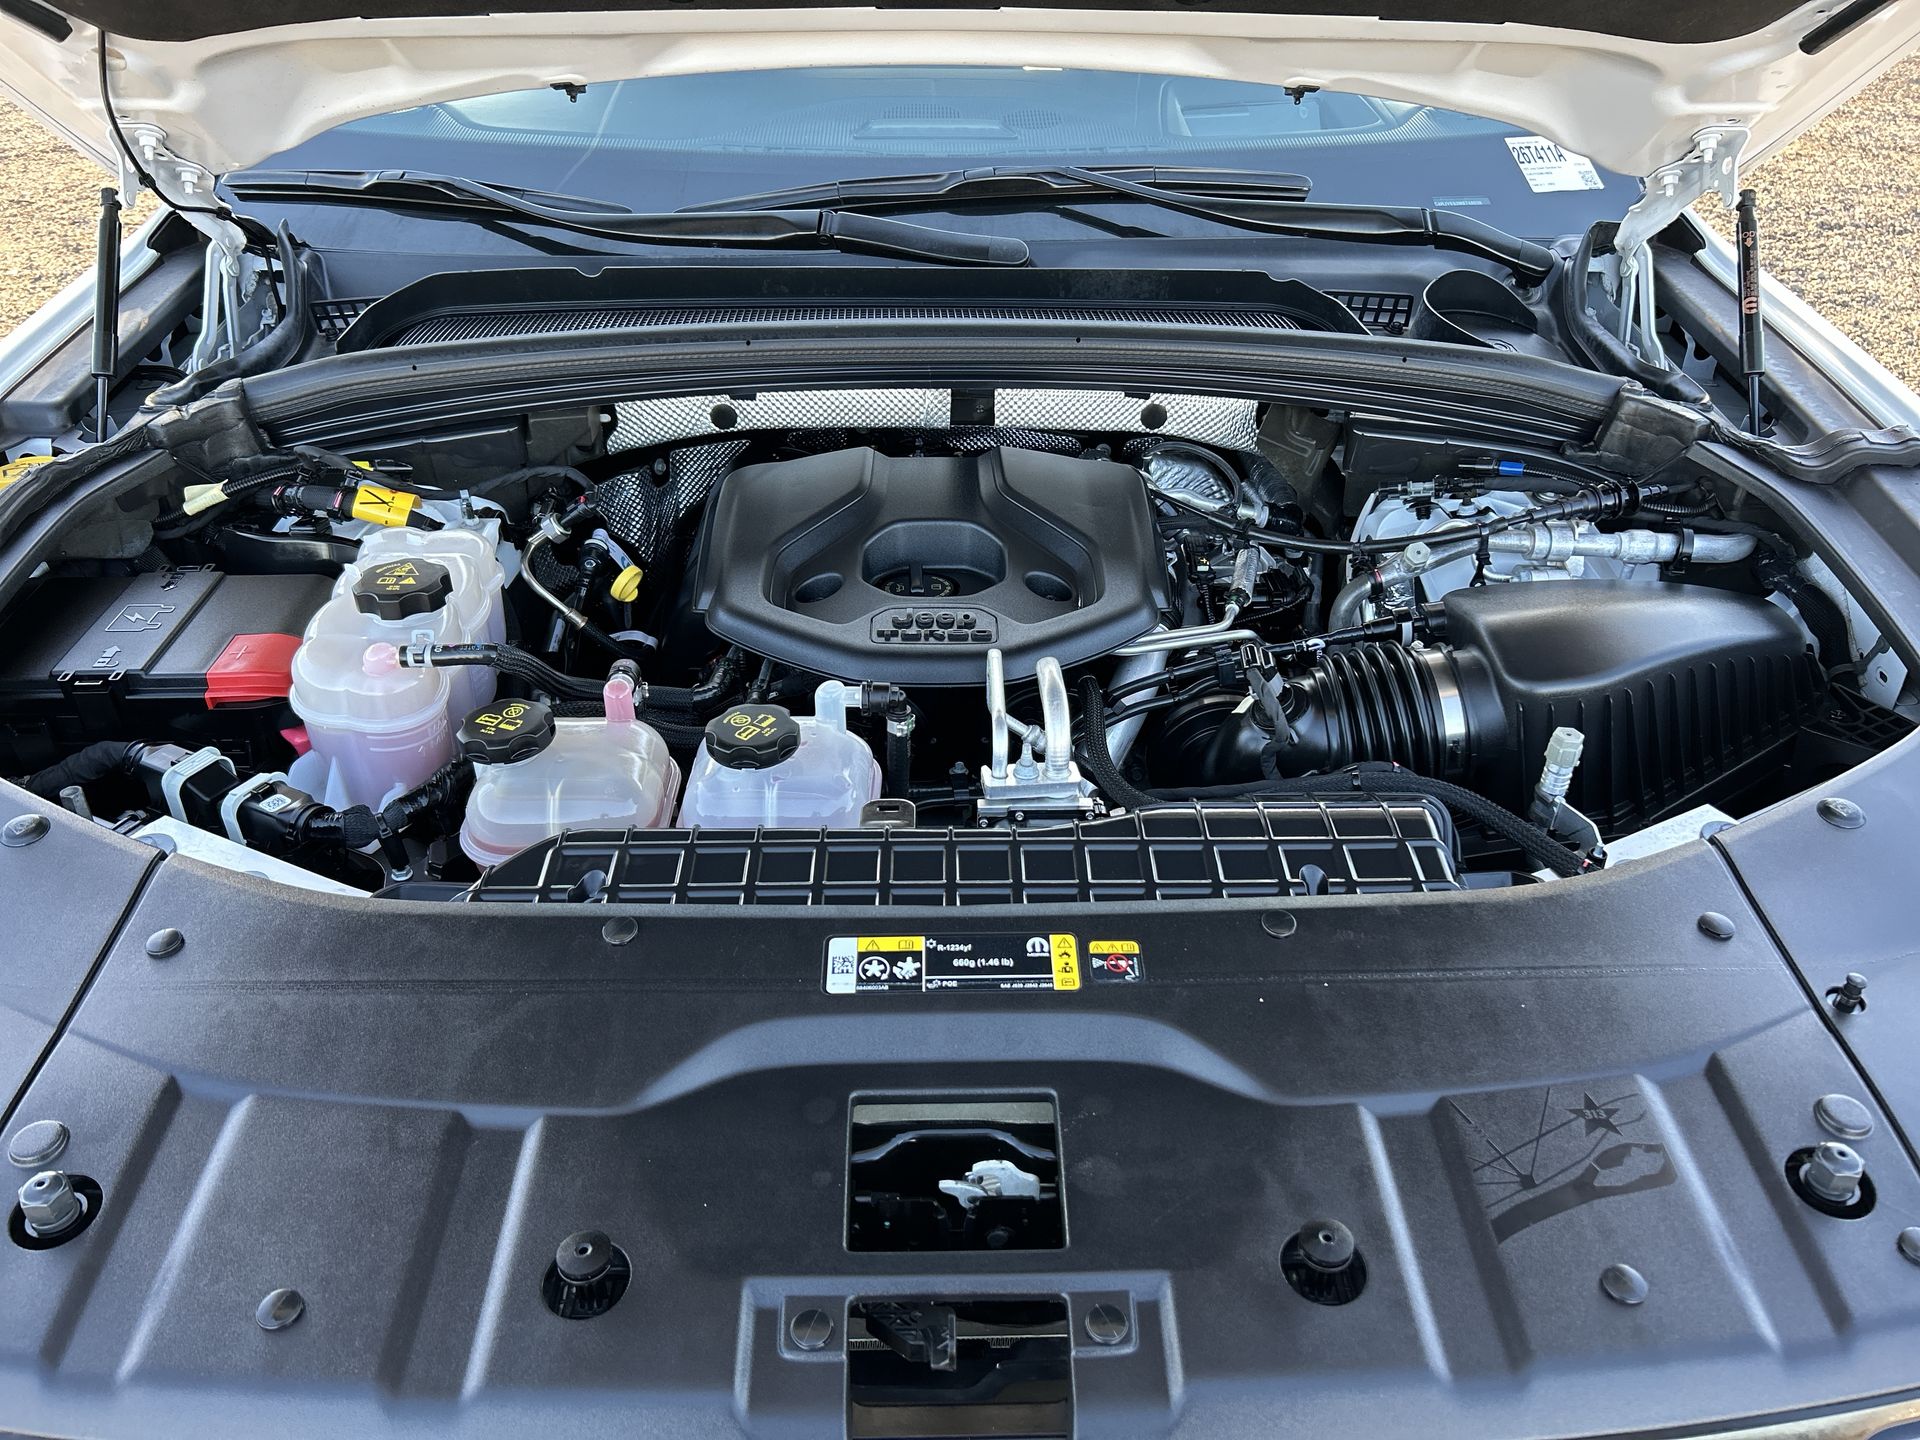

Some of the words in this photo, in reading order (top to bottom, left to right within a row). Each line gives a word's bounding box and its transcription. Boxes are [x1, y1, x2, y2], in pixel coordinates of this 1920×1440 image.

[1511, 144, 1567, 165] 26T411A
[937, 943, 972, 953] R-1234yf
[952, 958, 976, 968] 660g
[977, 958, 1000, 968] (1.46
[1001, 958, 1014, 967] lb)
[1582, 1109, 1607, 1120] 313
